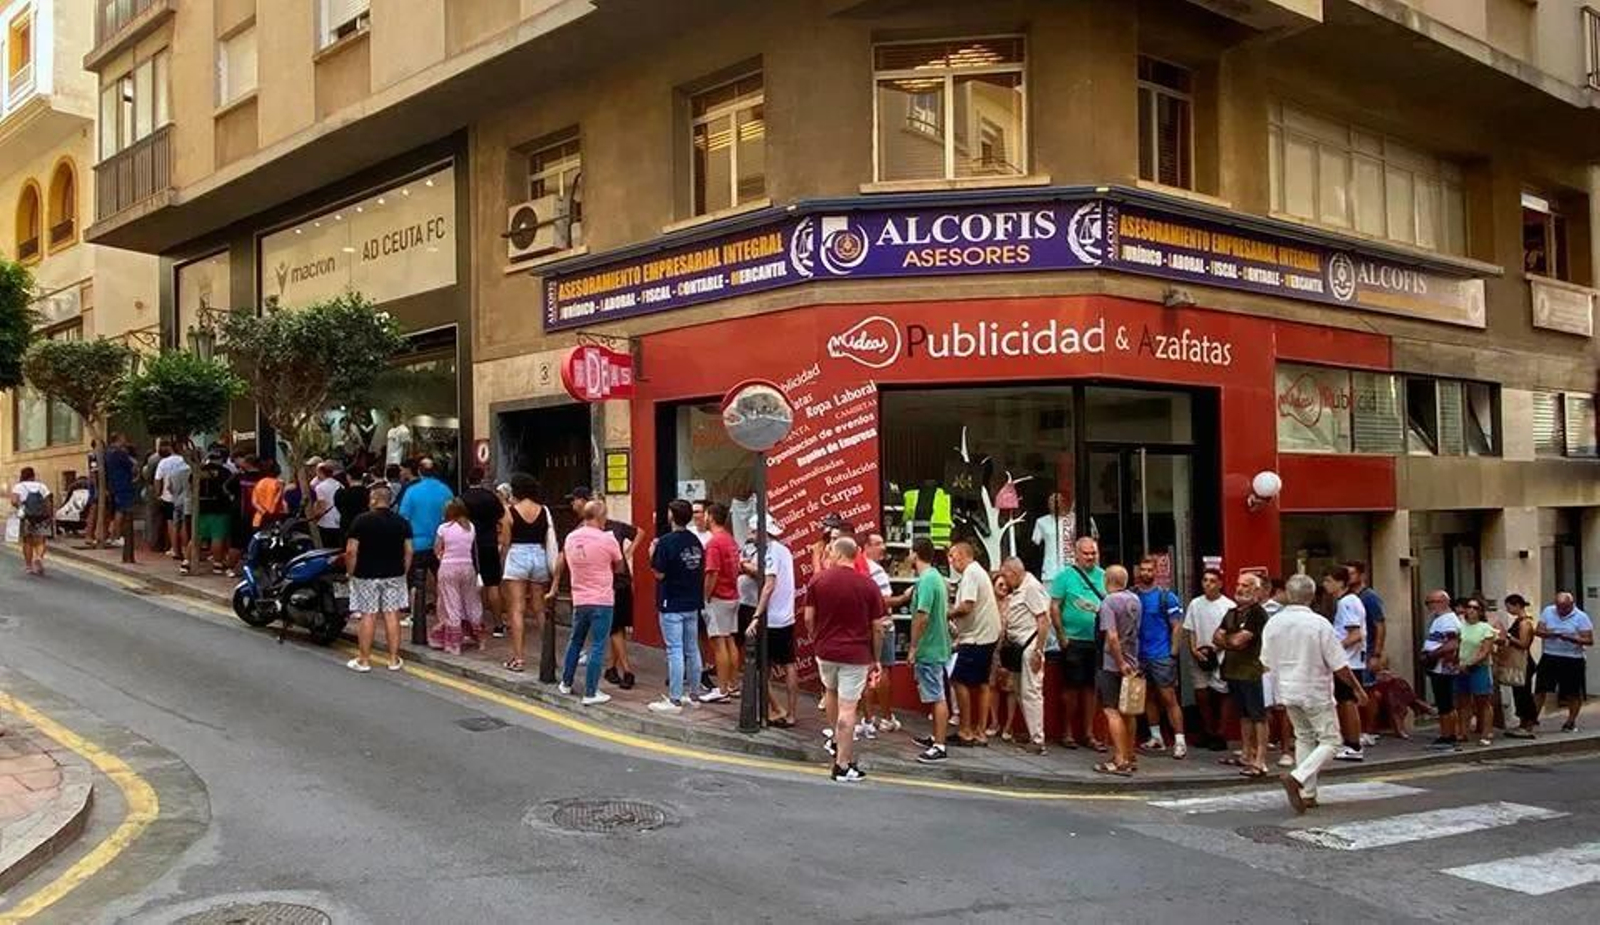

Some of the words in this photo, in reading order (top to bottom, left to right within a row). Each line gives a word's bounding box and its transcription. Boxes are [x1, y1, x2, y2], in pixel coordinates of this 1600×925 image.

[362, 239, 379, 262] AD
[382, 224, 424, 256] CEUTA
[427, 216, 446, 243] FC
[876, 210, 1056, 246] ALCOFIS
[1119, 214, 1211, 253] ASESORAMIENTO
[1212, 232, 1278, 264] EMPRESARIAL
[1279, 246, 1321, 273] INTEGRAL
[291, 256, 336, 284] macron
[558, 266, 641, 301] ASESORAMIENTO
[642, 247, 722, 284] EMPRESARIAL
[723, 232, 785, 265] INTEGRAL
[902, 245, 1031, 268] ASESORES
[1168, 253, 1205, 273] LABORAL
[1210, 260, 1238, 279] FISCAL
[1243, 266, 1280, 286] CONTABLE
[1284, 273, 1324, 293] MERCANTIL
[600, 292, 637, 313] LABORAL
[641, 285, 672, 304] FISCAL
[677, 274, 724, 297] CONTABLE
[730, 260, 788, 286] MERCANTIL
[1358, 262, 1428, 294] ALCOFIS
[906, 317, 1106, 358] Publicidad
[1115, 326, 1130, 351] &
[1138, 323, 1231, 366] Azafatas
[806, 401, 833, 418] Ropa
[833, 380, 876, 406] Laboral
[819, 429, 834, 441] de
[835, 414, 875, 434] eventos
[826, 442, 840, 454] de
[838, 428, 877, 450] Empresa
[825, 462, 878, 487] Rotulación
[806, 500, 820, 512] de
[821, 484, 864, 506] Carpas
